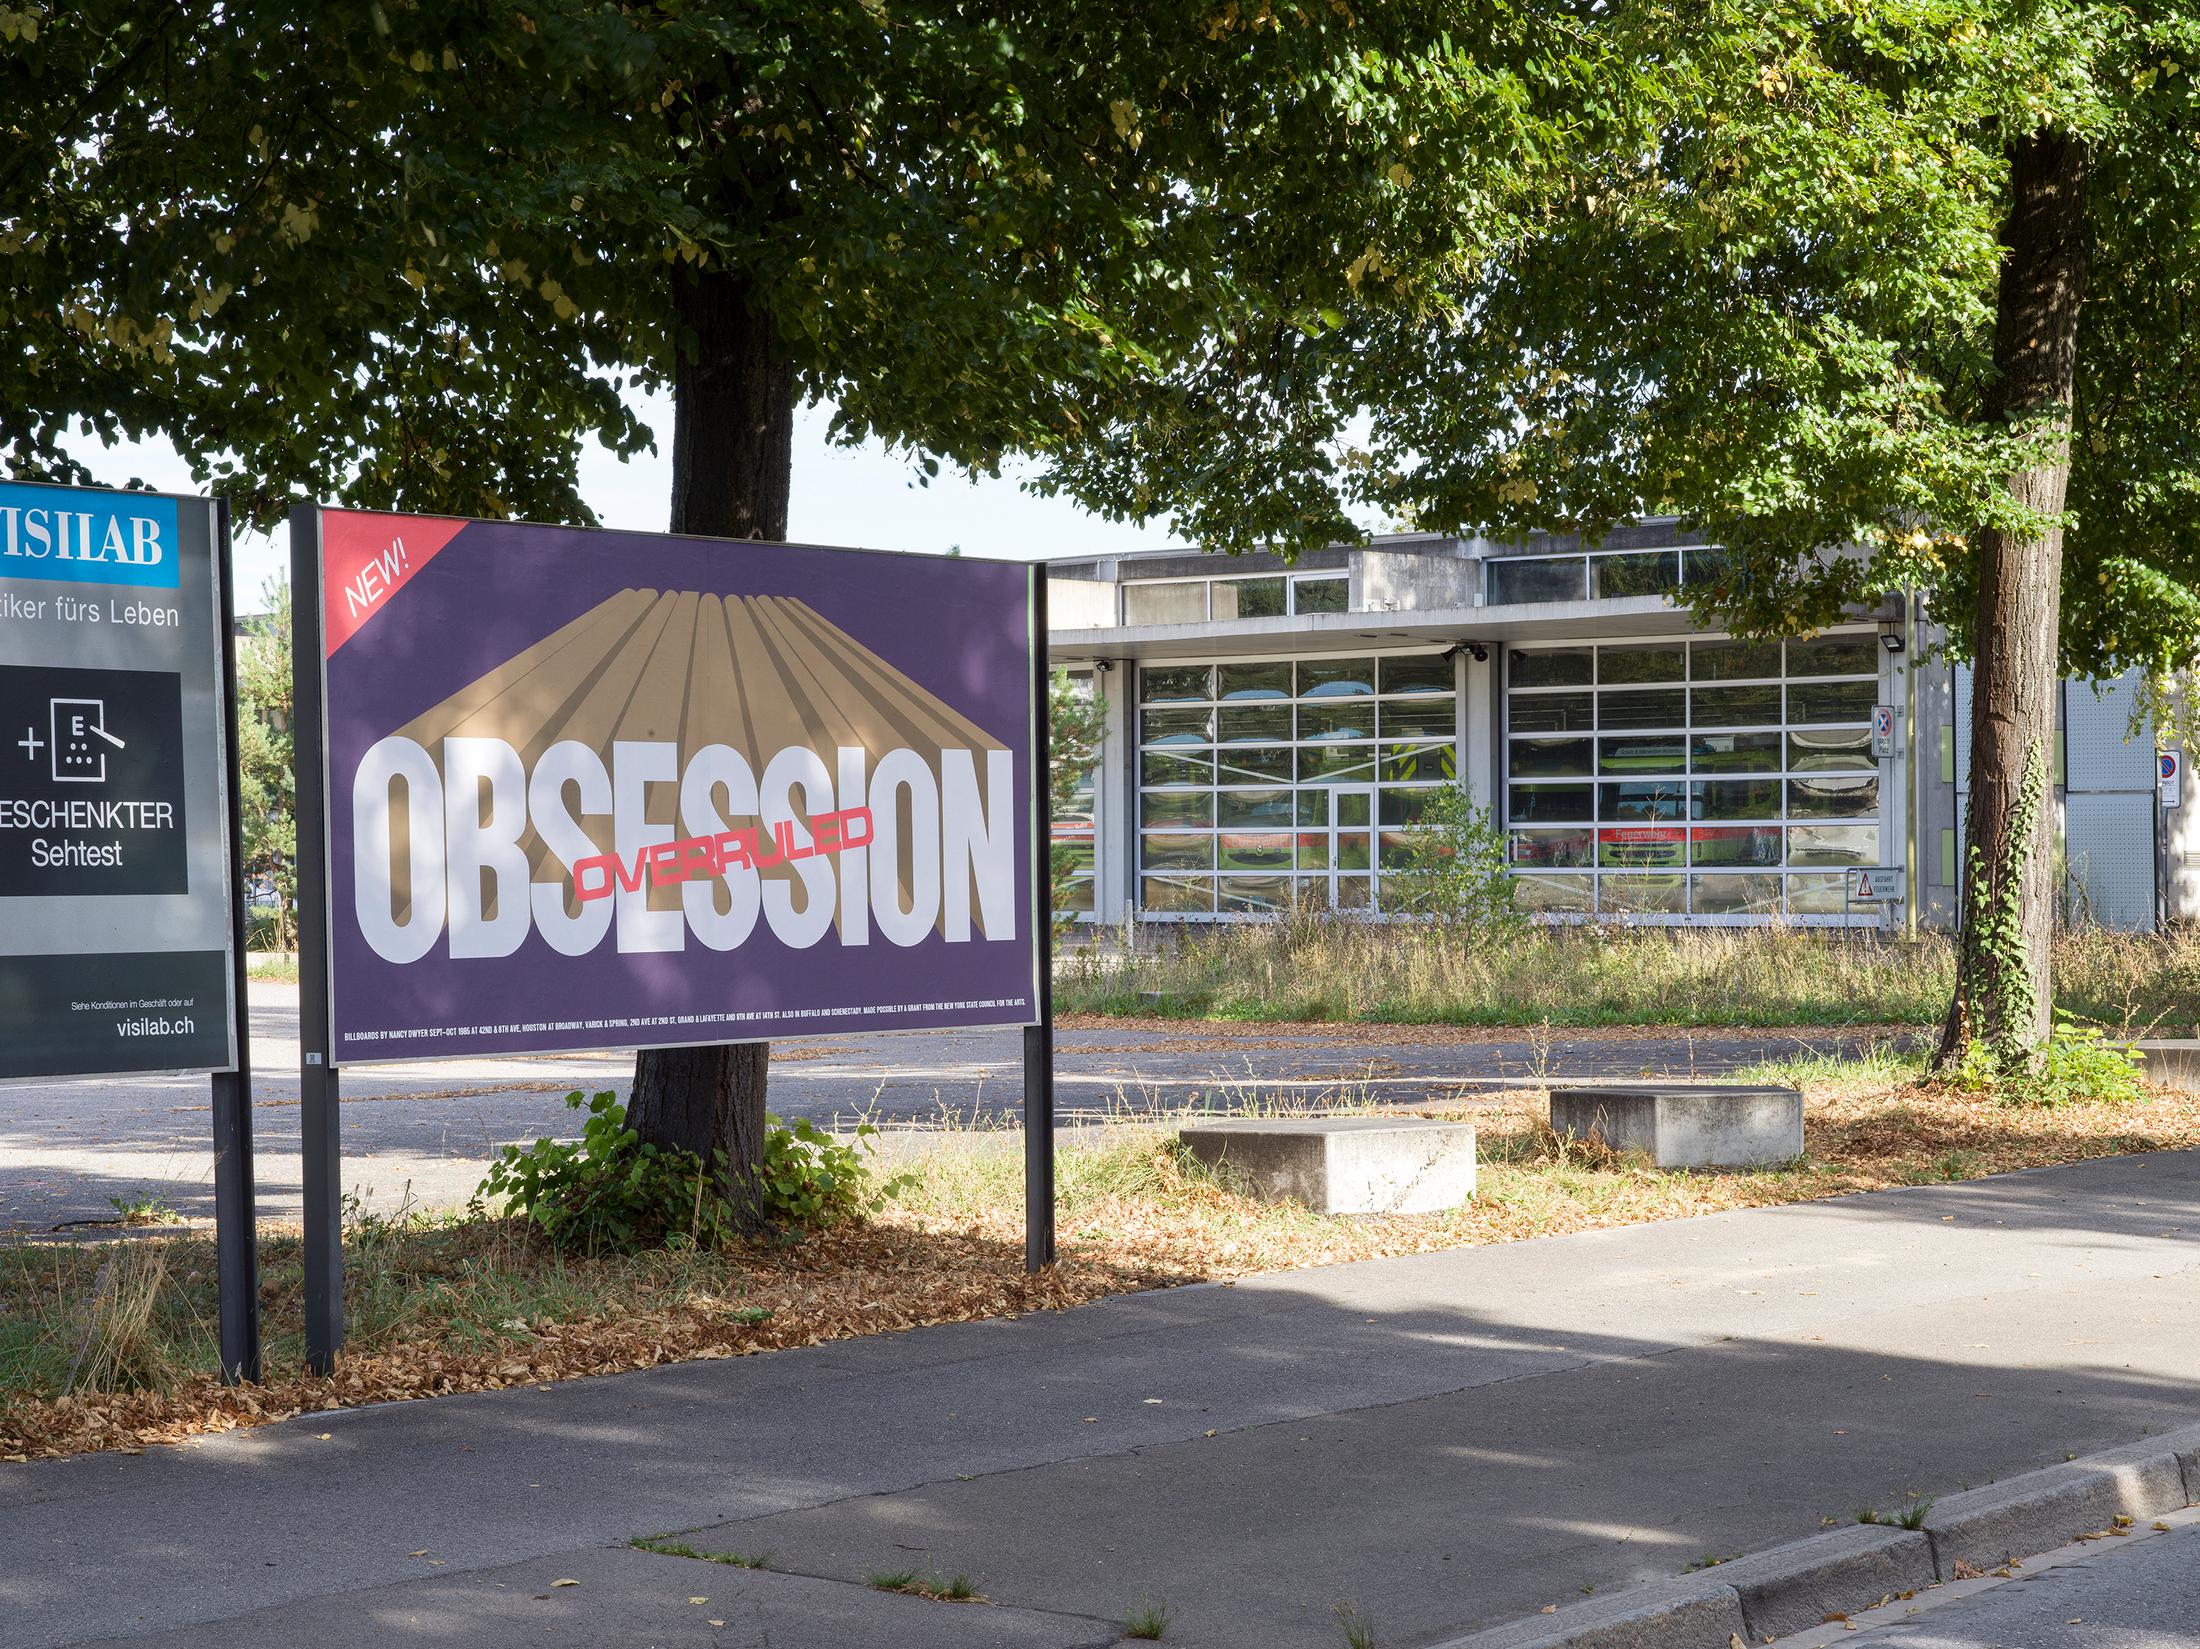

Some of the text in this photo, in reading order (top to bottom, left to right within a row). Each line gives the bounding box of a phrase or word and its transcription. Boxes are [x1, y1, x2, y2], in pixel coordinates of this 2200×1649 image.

[0, 506, 163, 566] ISILAB
[344, 536, 410, 619] NEW!
[0, 592, 180, 627] iker fürs Leben
[31, 838, 123, 867] Sehtest
[353, 736, 1017, 964] OBSESSION
[1615, 829, 1666, 840] Feuerwehr
[573, 806, 874, 902] OVERRULED
[71, 997, 194, 1010] Siehe Konditionen im Geschäft oder auf
[345, 1031, 379, 1040] BILLBOARDS
[380, 1031, 388, 1039] BY
[389, 1030, 407, 1038] NANCY
[408, 1029, 428, 1037] DWYER
[471, 1026, 478, 1034] AT
[493, 1025, 498, 1033] &
[522, 1023, 547, 1032] HOUSTON
[585, 1020, 604, 1028] VARICK
[630, 1018, 640, 1026] 2ND
[651, 1017, 657, 1025] AT
[700, 1014, 726, 1022] LAFAYETTE
[726, 1013, 736, 1021] AND
[746, 1012, 755, 1020] AVE
[801, 1009, 821, 1017] BUFFALO
[922, 1003, 935, 1011] FROM
[979, 1000, 996, 1008] COUNCIL
[117, 1016, 194, 1037] visilab.ch
